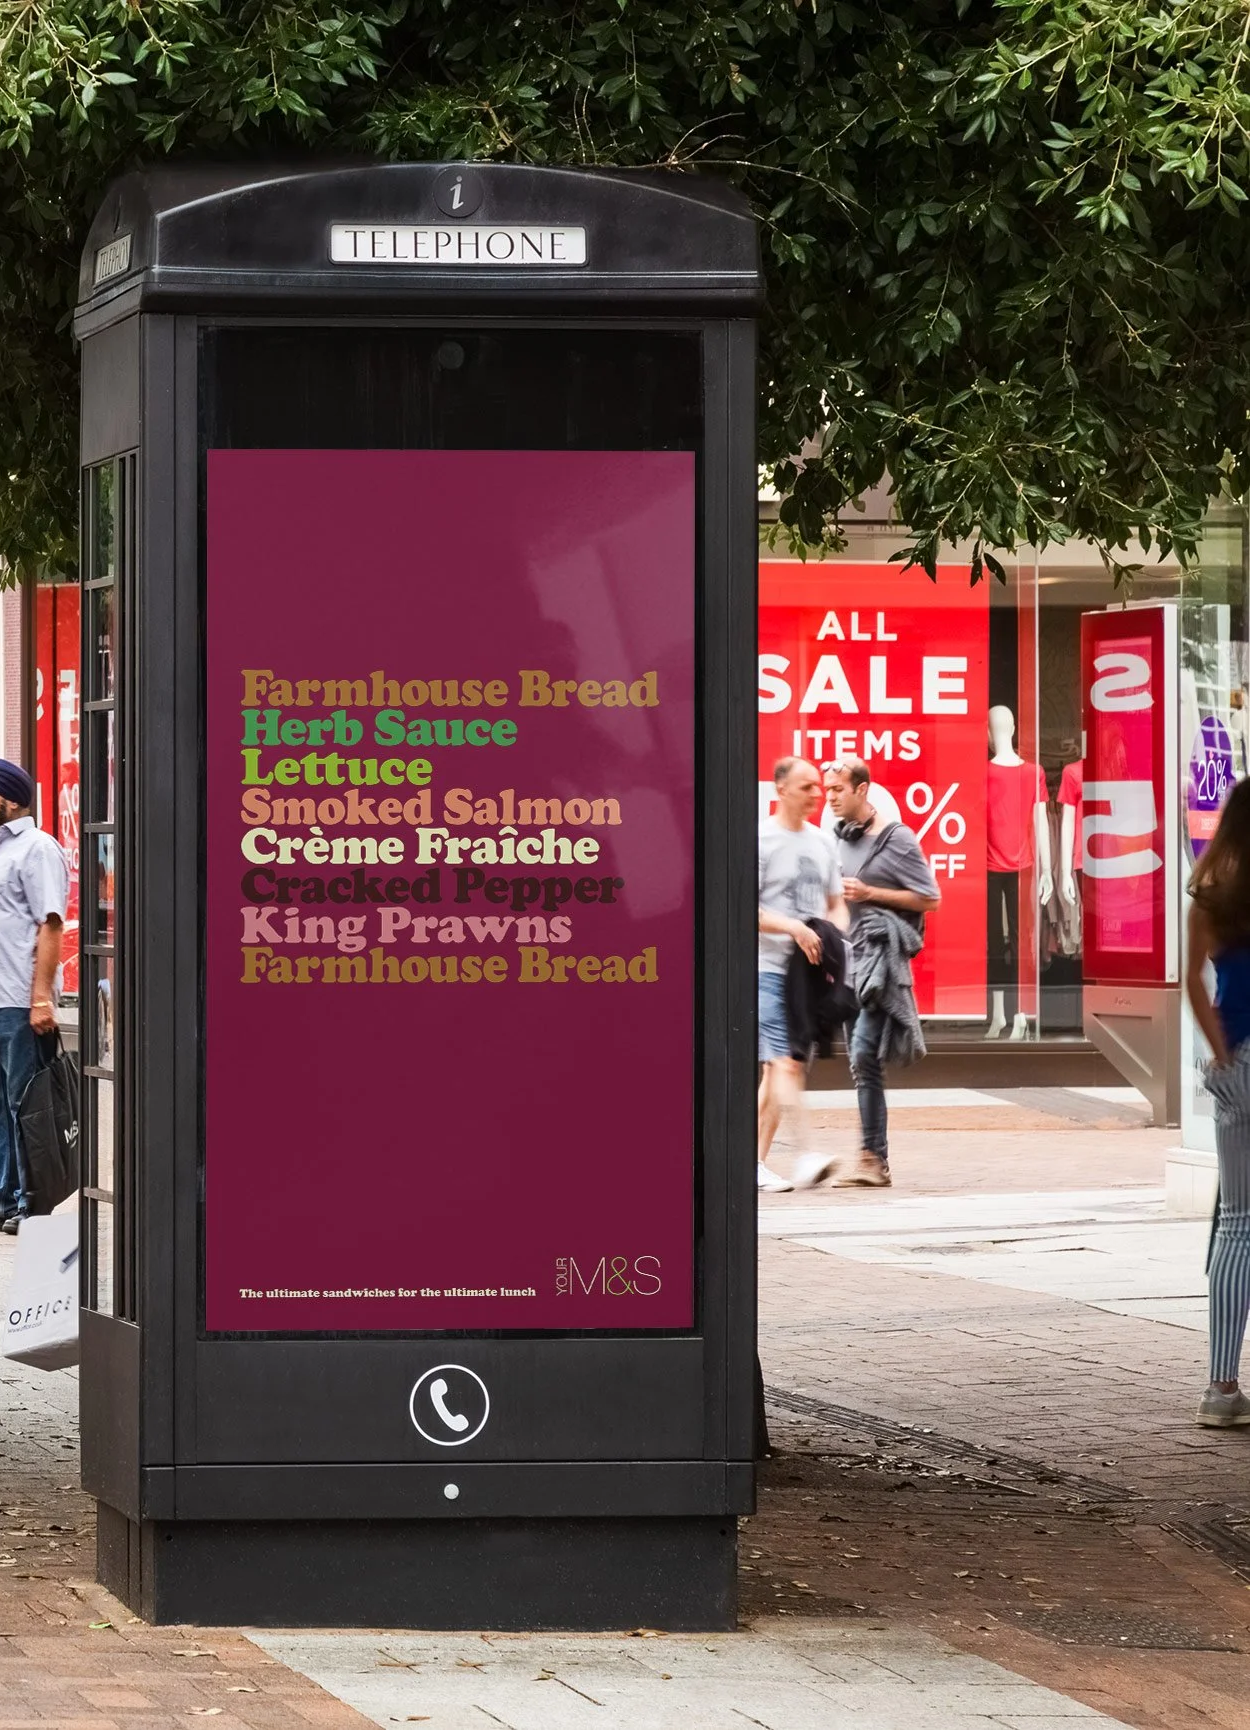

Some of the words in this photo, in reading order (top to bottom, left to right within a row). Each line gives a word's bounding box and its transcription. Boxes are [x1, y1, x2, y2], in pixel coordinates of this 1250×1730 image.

[344, 229, 567, 260] TELEPHONE
[816, 610, 898, 641] ALL
[240, 669, 508, 708] Farmhouse
[517, 670, 660, 708] Bread
[758, 653, 968, 715] SALE
[240, 709, 364, 746] Herb
[373, 709, 518, 746] Sauce
[793, 730, 921, 761] ITEMS
[240, 748, 433, 785] Lettuce
[240, 788, 433, 825] Smoked
[442, 788, 623, 825] Salmon
[240, 826, 405, 865] Crème
[414, 826, 600, 865] Fraîche
[930, 853, 966, 879] FF
[240, 868, 443, 904] Cracked
[453, 868, 625, 912] Pepper
[240, 907, 367, 953] King
[376, 907, 573, 944] Prawns
[239, 946, 509, 984] Farmhouse
[516, 946, 660, 984] Bread
[239, 1288, 263, 1299] The
[266, 1288, 320, 1298] ultimate
[322, 1288, 395, 1298] sandwiches
[398, 1287, 417, 1298] for
[420, 1287, 441, 1297] the
[443, 1287, 497, 1298] ultimate
[499, 1287, 536, 1297] lunch
[555, 1257, 568, 1297] YOUR
[569, 1255, 662, 1296] M&S
